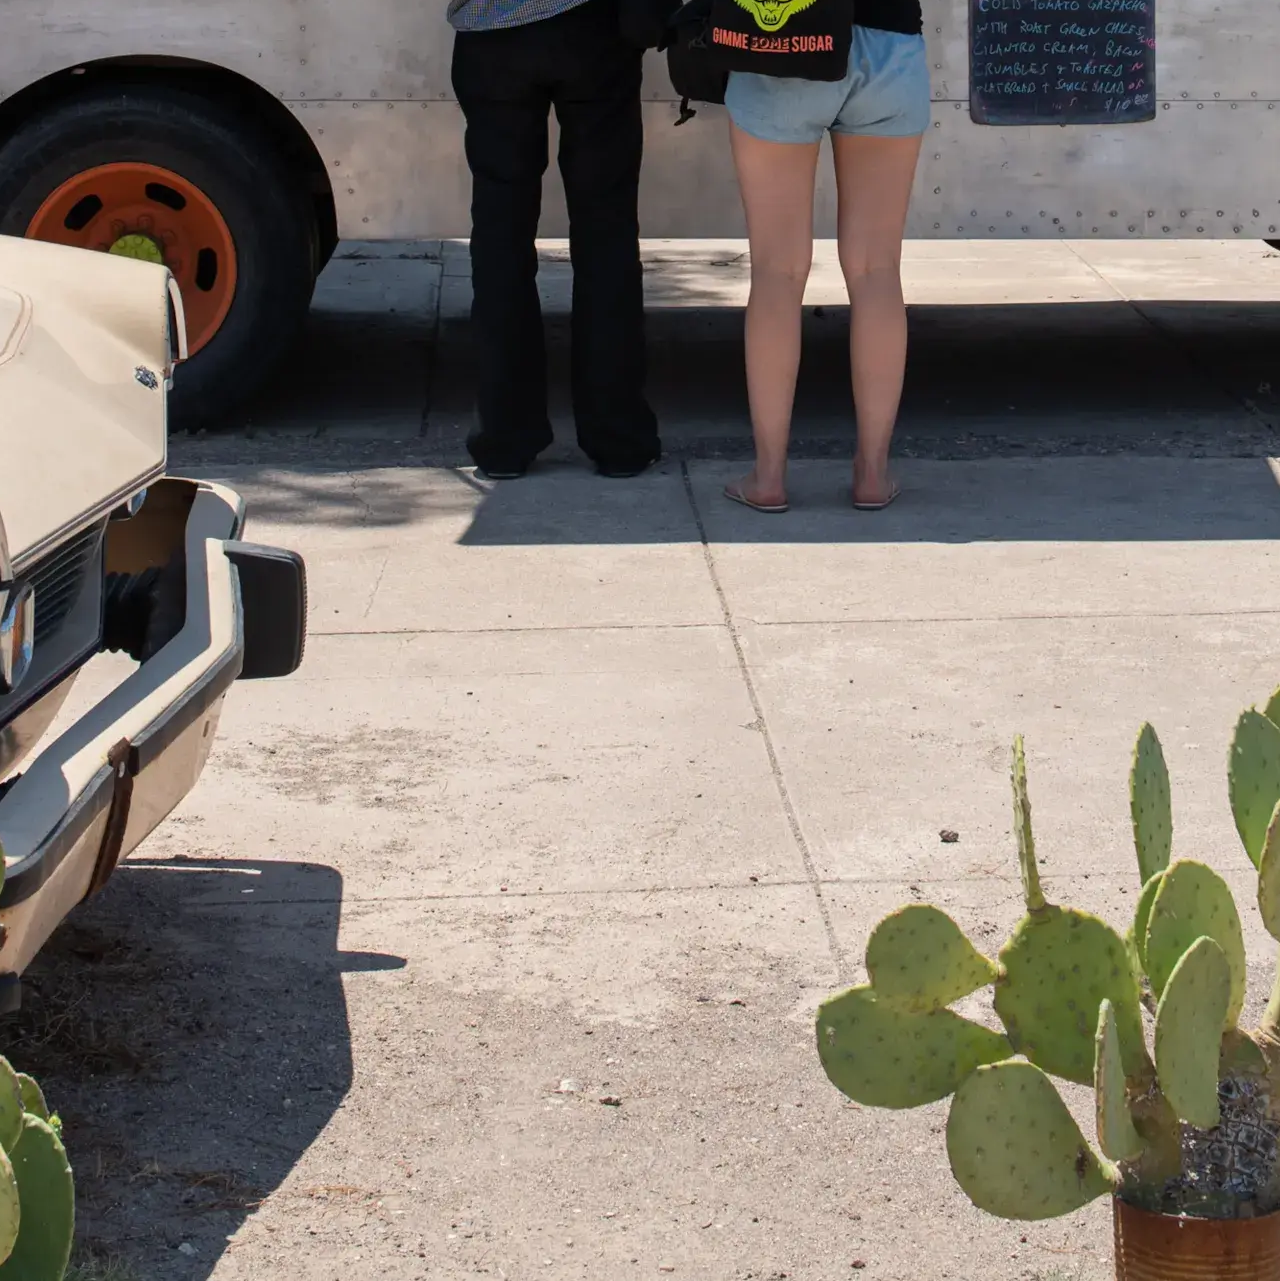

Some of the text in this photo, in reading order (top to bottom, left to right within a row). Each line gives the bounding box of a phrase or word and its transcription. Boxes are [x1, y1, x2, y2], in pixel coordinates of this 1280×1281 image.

[976, 22, 1008, 35] WITH
[1020, 19, 1052, 34] ROAST
[712, 27, 833, 52] GIMME SOME SUGAR
[973, 41, 1036, 56] CILANTRO
[1105, 39, 1142, 57] BACON
[974, 62, 1049, 76] CRUMBLES
[1070, 62, 1123, 77] TOASTED
